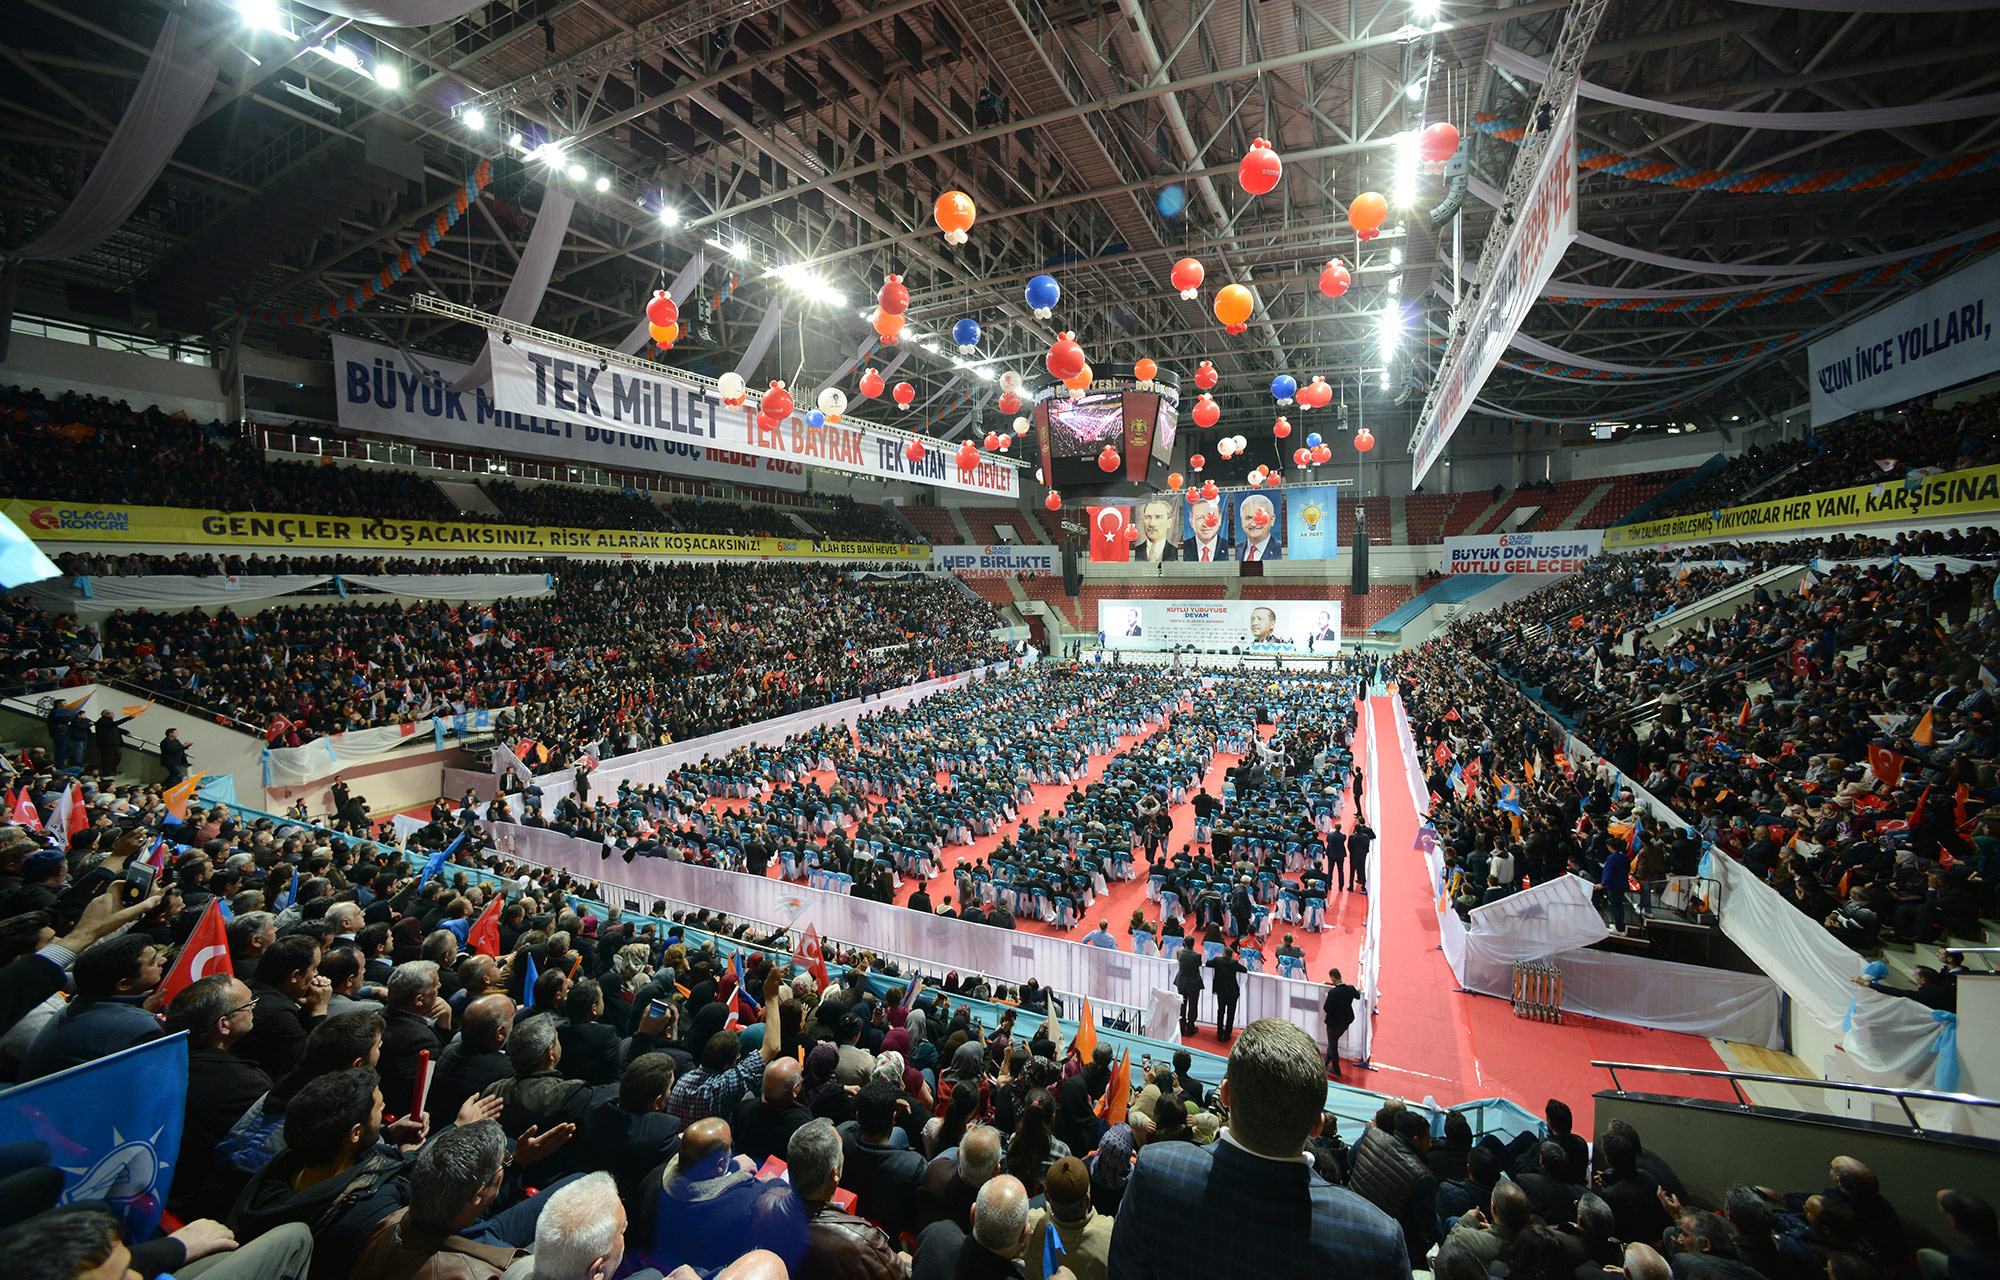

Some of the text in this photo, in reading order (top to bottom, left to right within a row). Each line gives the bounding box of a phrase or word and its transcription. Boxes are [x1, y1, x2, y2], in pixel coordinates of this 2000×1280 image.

[1855, 338, 1893, 382] İNCE
[1898, 299, 1991, 365] YOLLARI,
[346, 357, 467, 422] BÜYÜK
[528, 351, 602, 418] TEK
[743, 404, 786, 452] TEK
[791, 416, 864, 466] BAYRAK
[876, 437, 904, 474] TEK
[957, 463, 975, 485] TEK
[978, 461, 1011, 491] DEVLET
[1628, 528, 1640, 540] TÜM
[1641, 522, 1672, 539] ZALİMLER
[1672, 513, 1713, 536] BİRLEŞMİŞ
[1716, 504, 1780, 530] YIKIYORLAR
[1783, 501, 1811, 523] HER
[1816, 494, 1860, 518] YANI,
[1865, 474, 1999, 514] KARŞISINA
[60, 519, 129, 531] KONGRE
[202, 516, 350, 542] GENÇLER
[362, 523, 544, 547] KOŞACAKSINIZ,
[551, 528, 591, 546] RİSK
[597, 533, 659, 548] ALARAK
[665, 537, 761, 552] KOŞACAKSINIZ!
[841, 544, 856, 554] BES
[857, 543, 875, 554] BAKİ
[876, 545, 898, 555] HEVES
[1451, 545, 1588, 560] BÜYÜK DÖNÜŞÜM
[942, 556, 976, 568] HEP
[1451, 559, 1586, 573] KUTLU GELECEK
